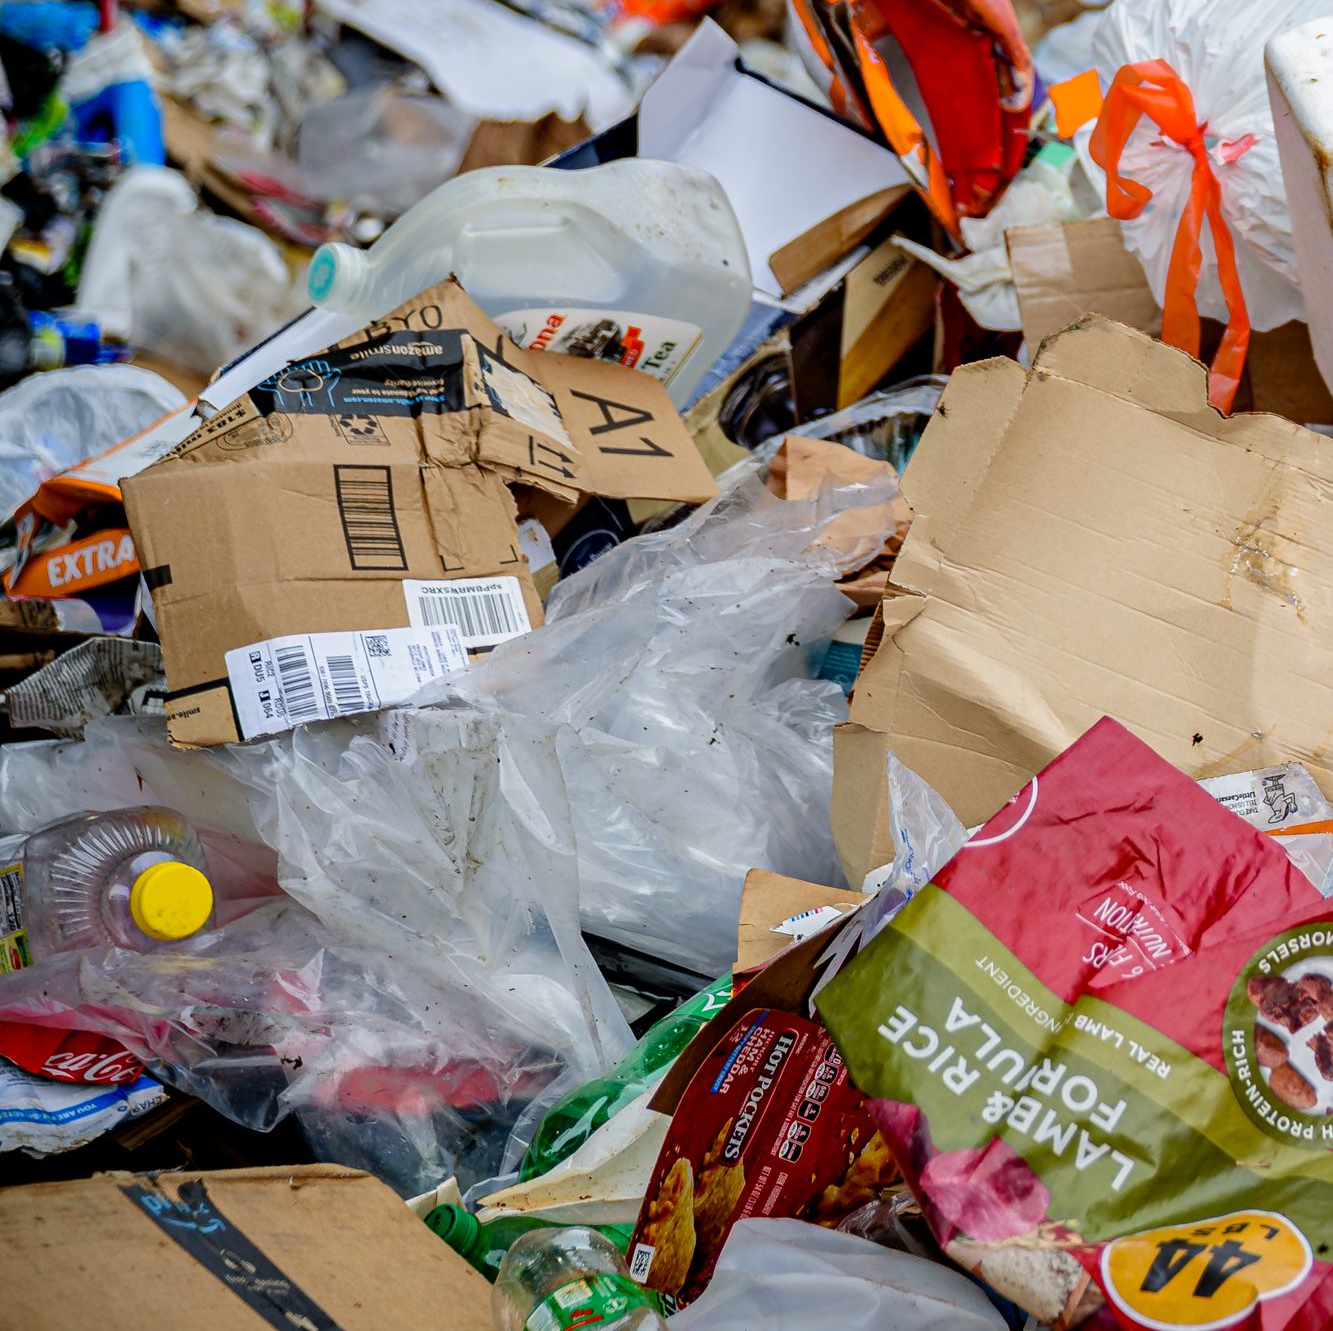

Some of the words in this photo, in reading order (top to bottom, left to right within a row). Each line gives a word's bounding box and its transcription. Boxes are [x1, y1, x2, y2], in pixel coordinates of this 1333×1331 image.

[351, 341, 444, 362] amazonsmile
[641, 341, 677, 371] Tea
[568, 387, 675, 458] A1
[47, 534, 135, 588] EXTRA
[975, 955, 1066, 1034] INGREDIENT
[720, 1027, 762, 1093] CHEDDAR
[763, 1035, 793, 1077] HOT
[877, 1004, 981, 1096] RICE
[1073, 1013, 1125, 1049] LAMB
[1128, 1039, 1172, 1080] REAL
[981, 1089, 1015, 1124] &
[1232, 1029, 1314, 1140] PROTEIN-RICH
[724, 1073, 774, 1160] POCKETS
[1006, 1094, 1135, 1192] LAMB
[1139, 1236, 1264, 1299] 44
